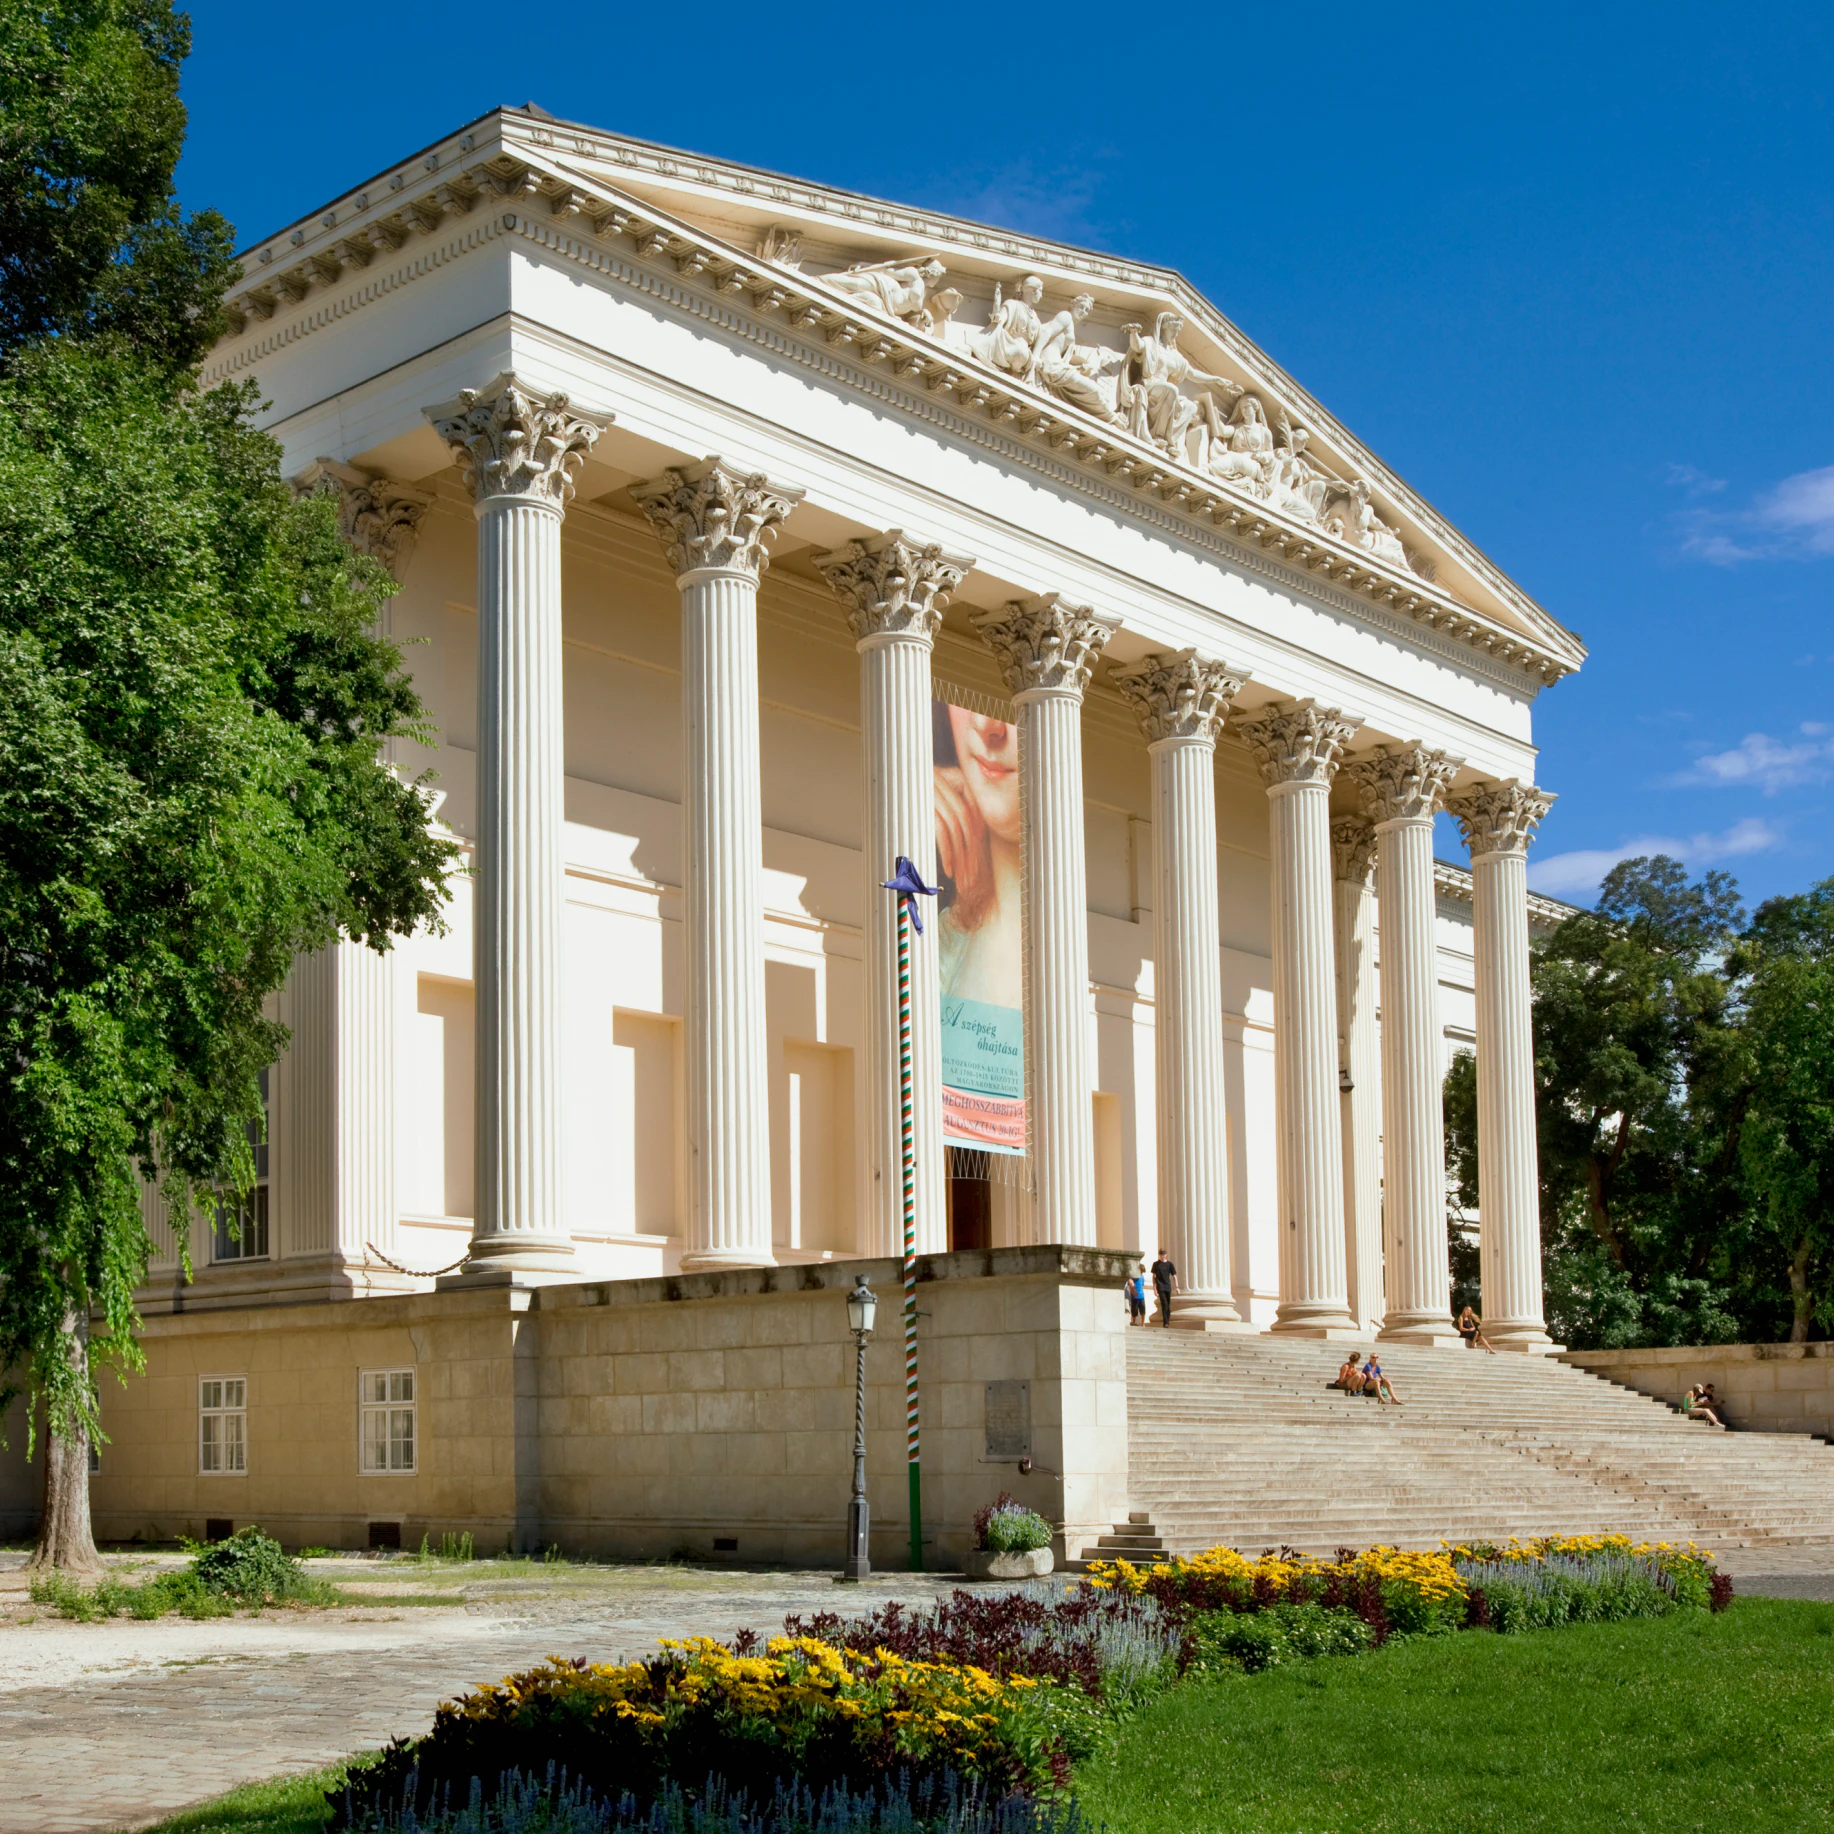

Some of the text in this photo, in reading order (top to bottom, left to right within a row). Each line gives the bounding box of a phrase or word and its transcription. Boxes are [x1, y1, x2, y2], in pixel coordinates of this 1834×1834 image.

[940, 1003, 997, 1038] A szépség
[977, 1037, 1018, 1056] óhajtása
[943, 1114, 996, 1135] AUGUSZTUS
